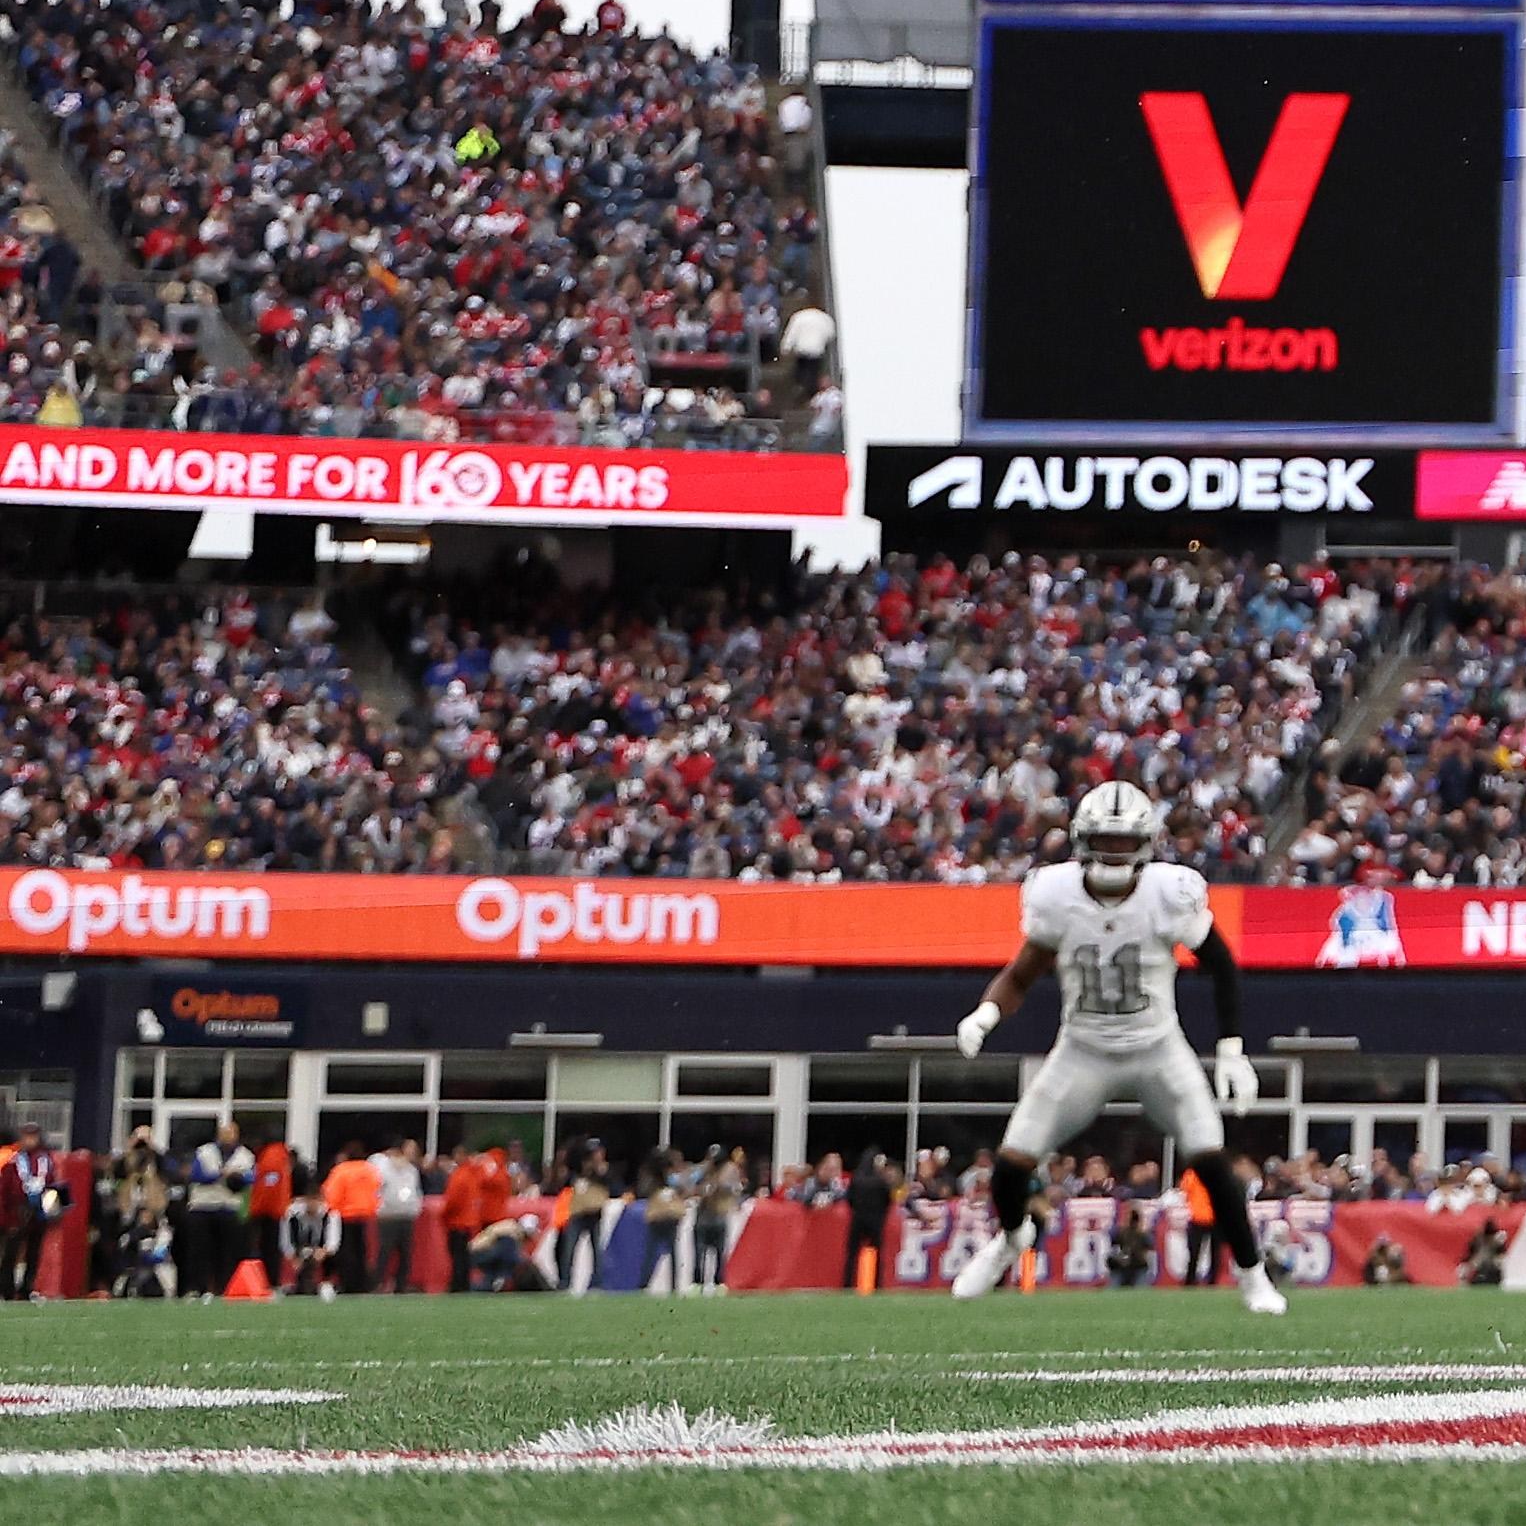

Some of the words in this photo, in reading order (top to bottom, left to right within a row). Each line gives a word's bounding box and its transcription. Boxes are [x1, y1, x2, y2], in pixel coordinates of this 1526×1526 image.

[1139, 318, 1339, 371] verizon
[2, 441, 116, 489] AND
[128, 447, 279, 495] MORE
[286, 454, 387, 499] FOR
[507, 460, 669, 508] YEARS
[994, 456, 1375, 510] AUTODESK
[9, 869, 271, 953] Optum
[455, 876, 720, 959] Optum
[171, 987, 280, 1027] Optum
[1074, 942, 1150, 1015] 11
